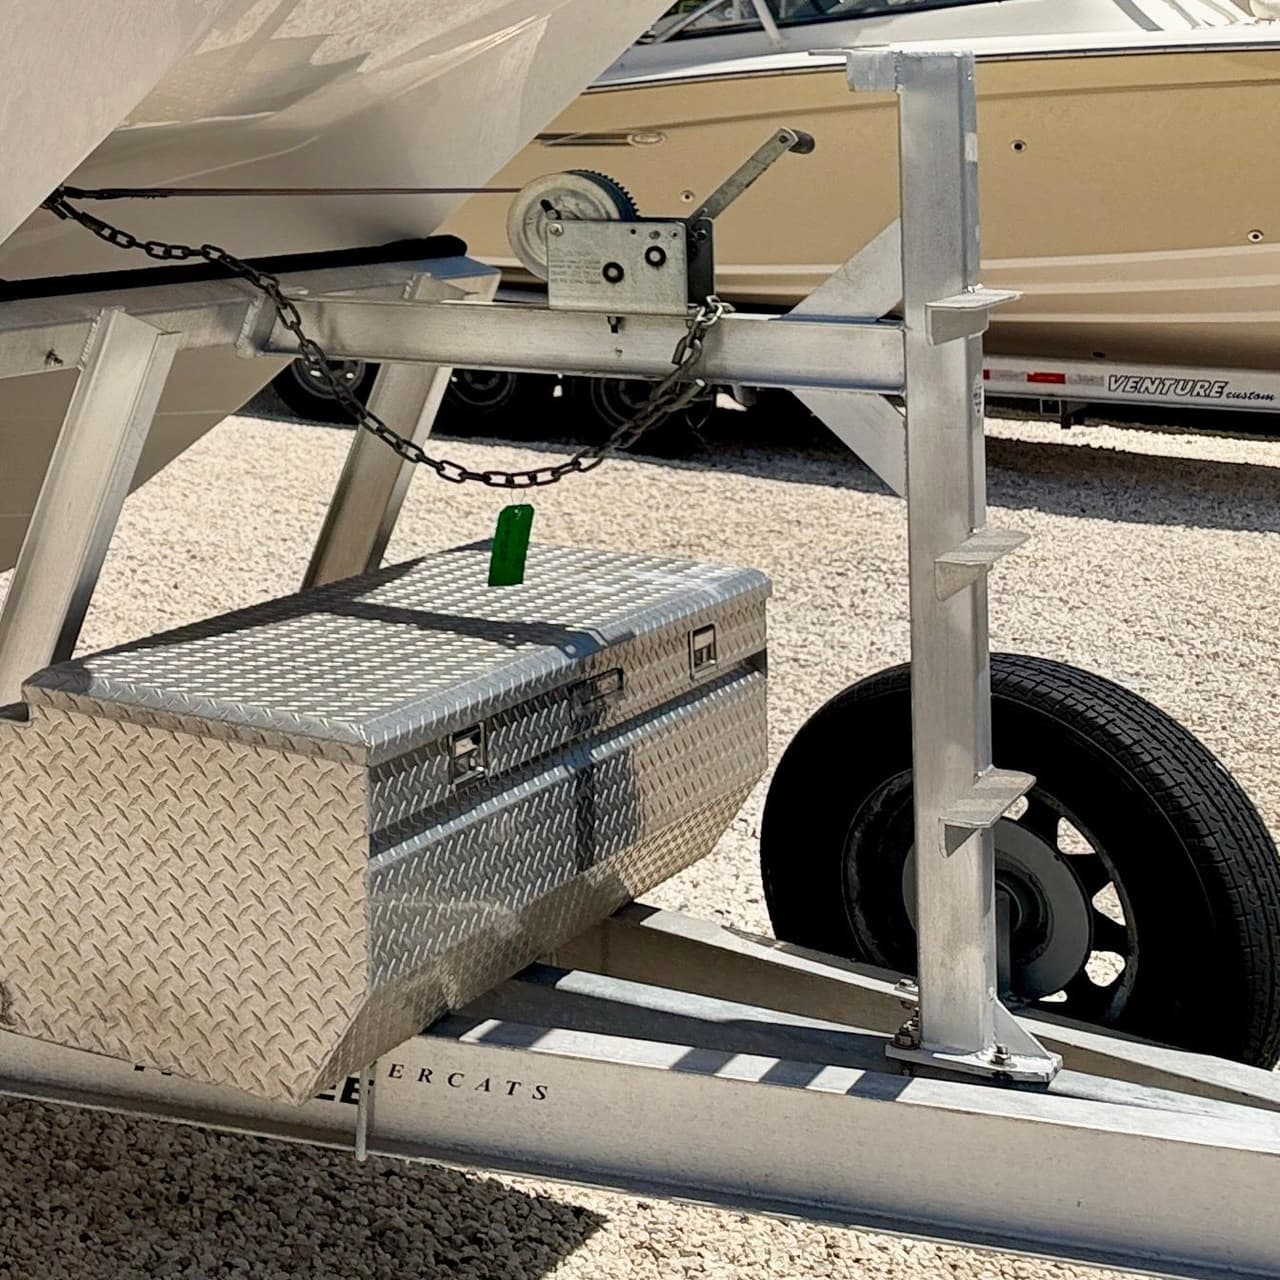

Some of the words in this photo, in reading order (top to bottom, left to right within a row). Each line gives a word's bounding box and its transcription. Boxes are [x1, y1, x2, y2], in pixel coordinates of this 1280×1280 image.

[1108, 374, 1229, 399] VENTURE
[1225, 391, 1275, 401] custom
[388, 1063, 549, 1101] ERCATS
